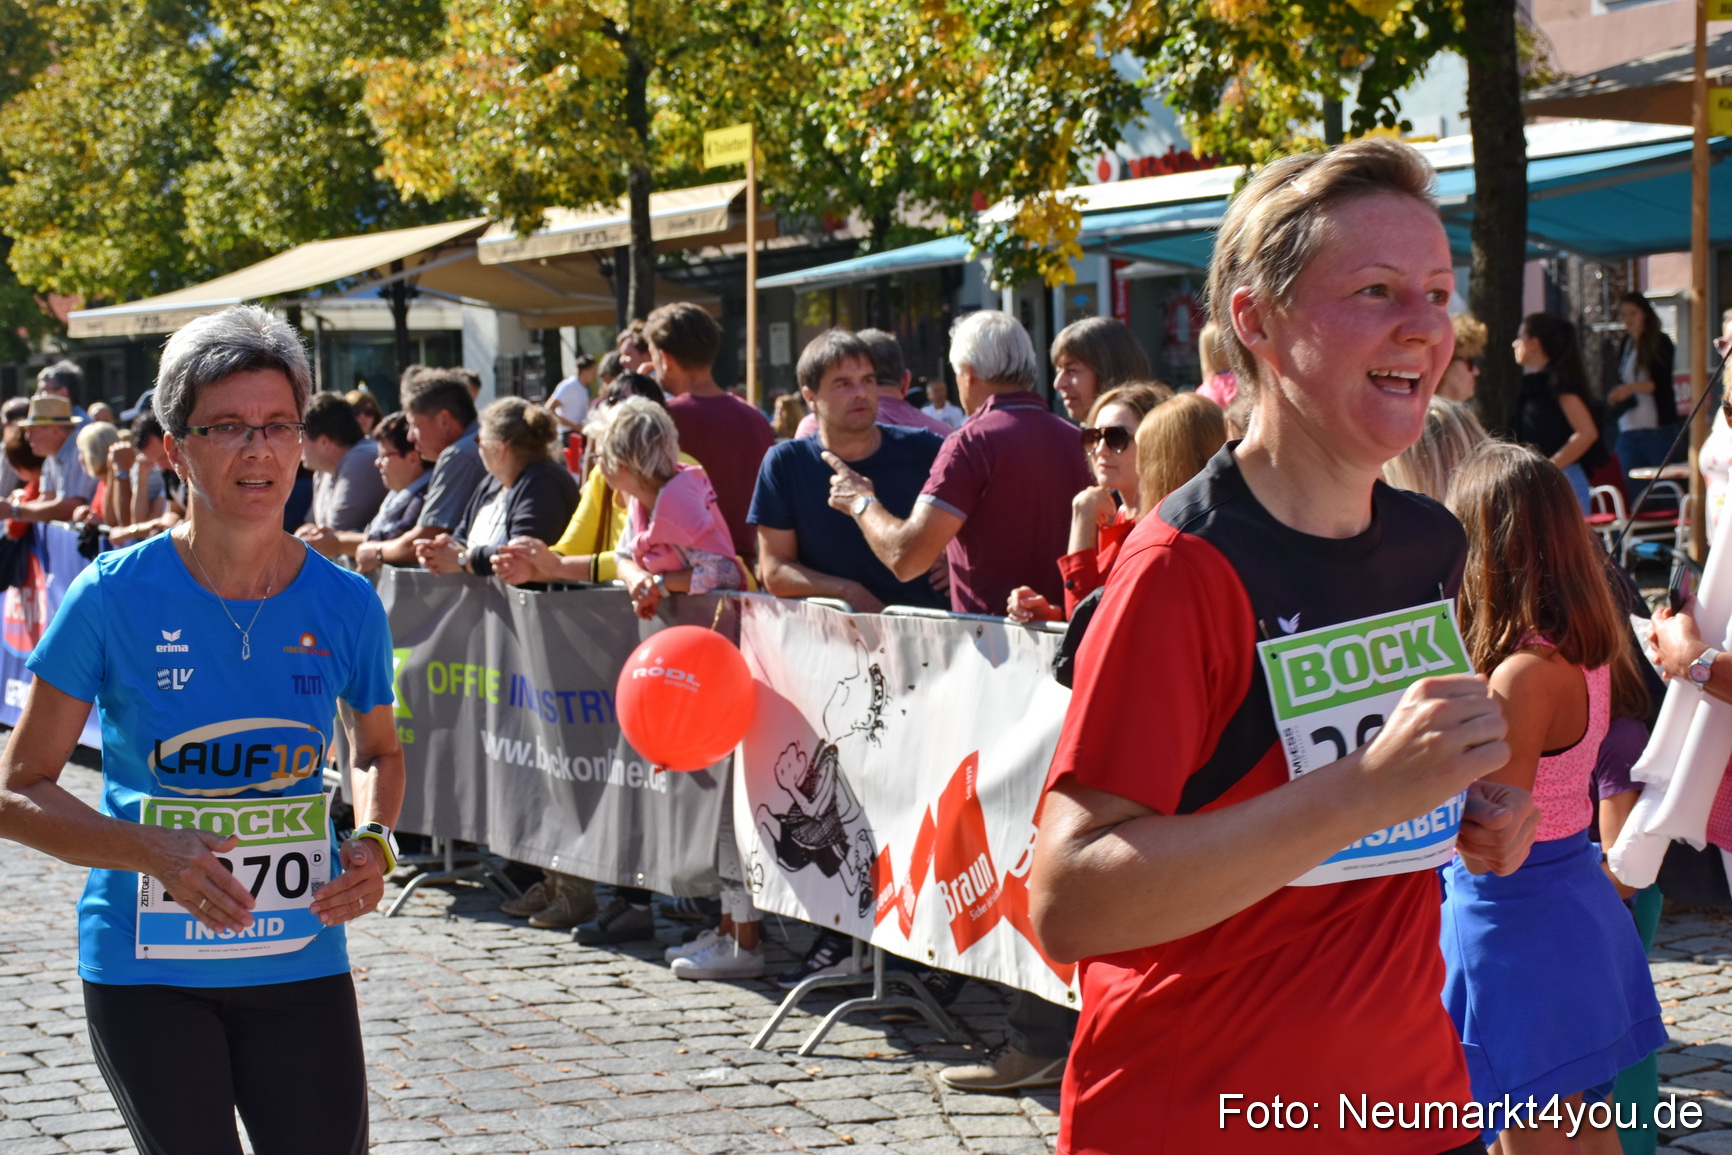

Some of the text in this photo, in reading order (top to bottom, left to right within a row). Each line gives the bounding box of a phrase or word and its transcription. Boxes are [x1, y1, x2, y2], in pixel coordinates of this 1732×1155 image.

[156, 643, 189, 653] erima
[1283, 619, 1450, 703] BOCK
[157, 668, 195, 691] BLV
[154, 739, 324, 780] LAUF10!
[158, 803, 312, 841] BOCK
[935, 852, 995, 924] Braun
